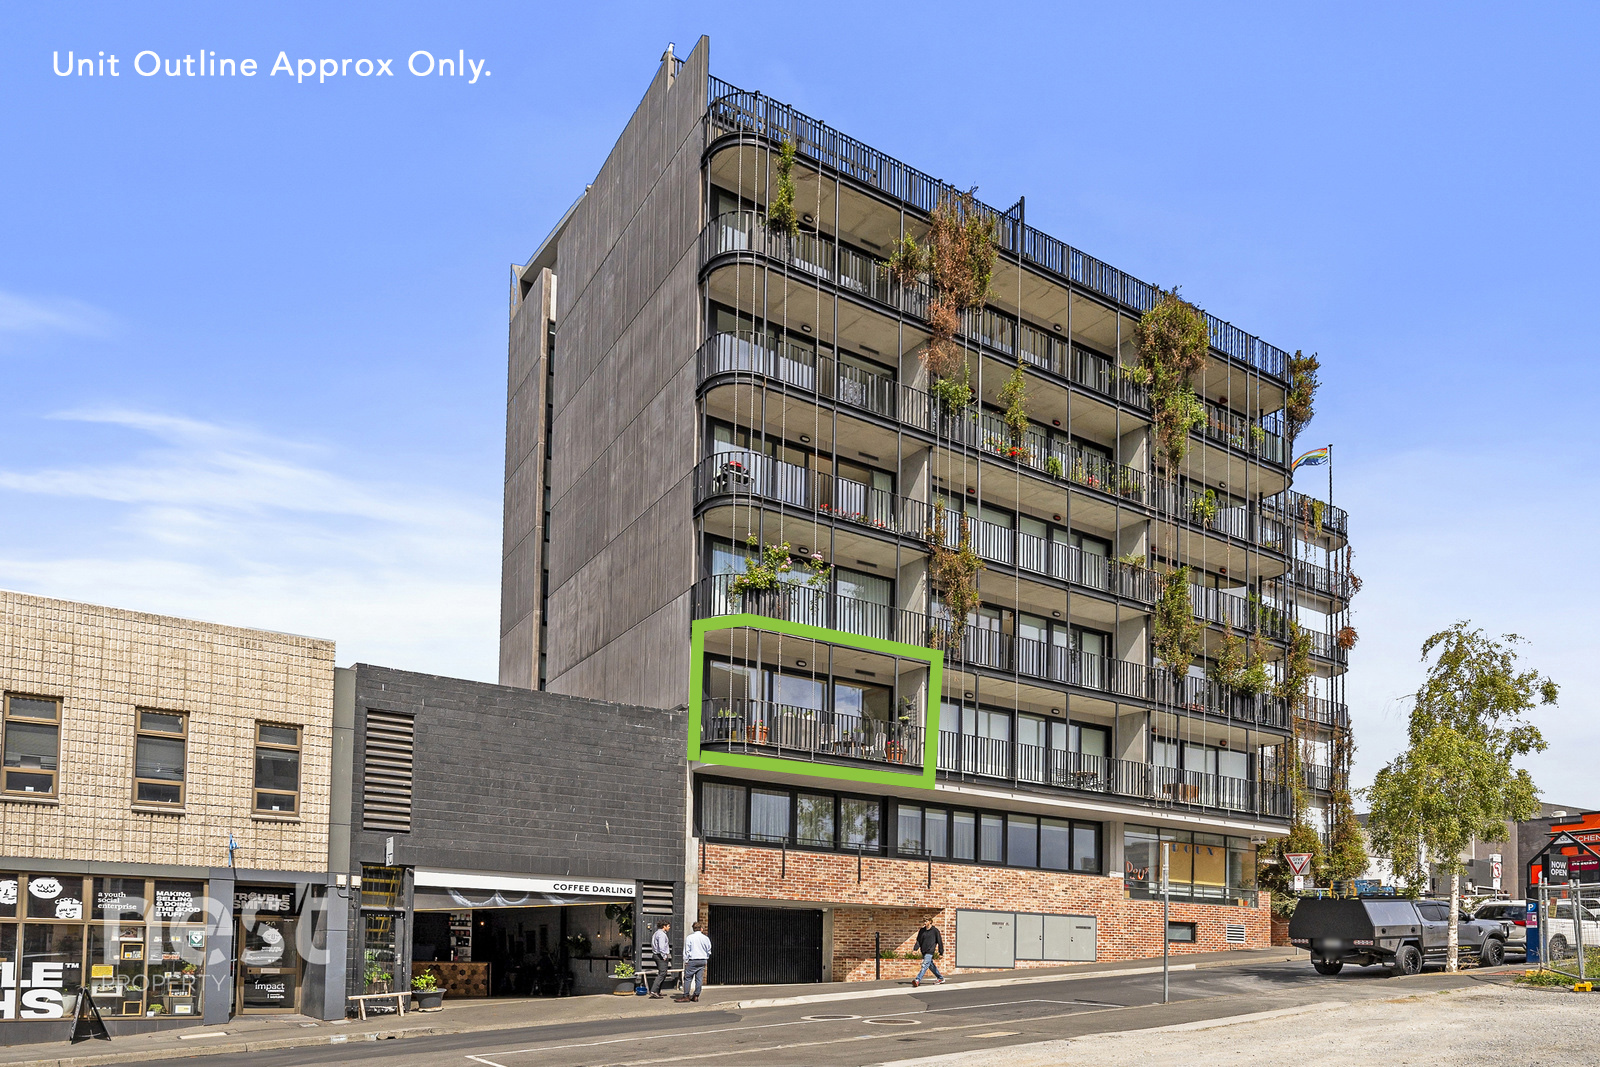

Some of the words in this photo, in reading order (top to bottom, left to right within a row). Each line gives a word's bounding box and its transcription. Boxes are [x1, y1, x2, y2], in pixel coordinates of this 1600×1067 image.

[1551, 861, 1567, 869] NOW
[1550, 868, 1567, 876] OPEN
[553, 883, 590, 892] COFFEE
[592, 885, 633, 895] DARLING
[104, 891, 127, 900] youth
[97, 903, 137, 911] enterprise
[233, 900, 290, 911] SMITHS
[1527, 903, 1534, 911] P
[254, 979, 285, 991] impact
